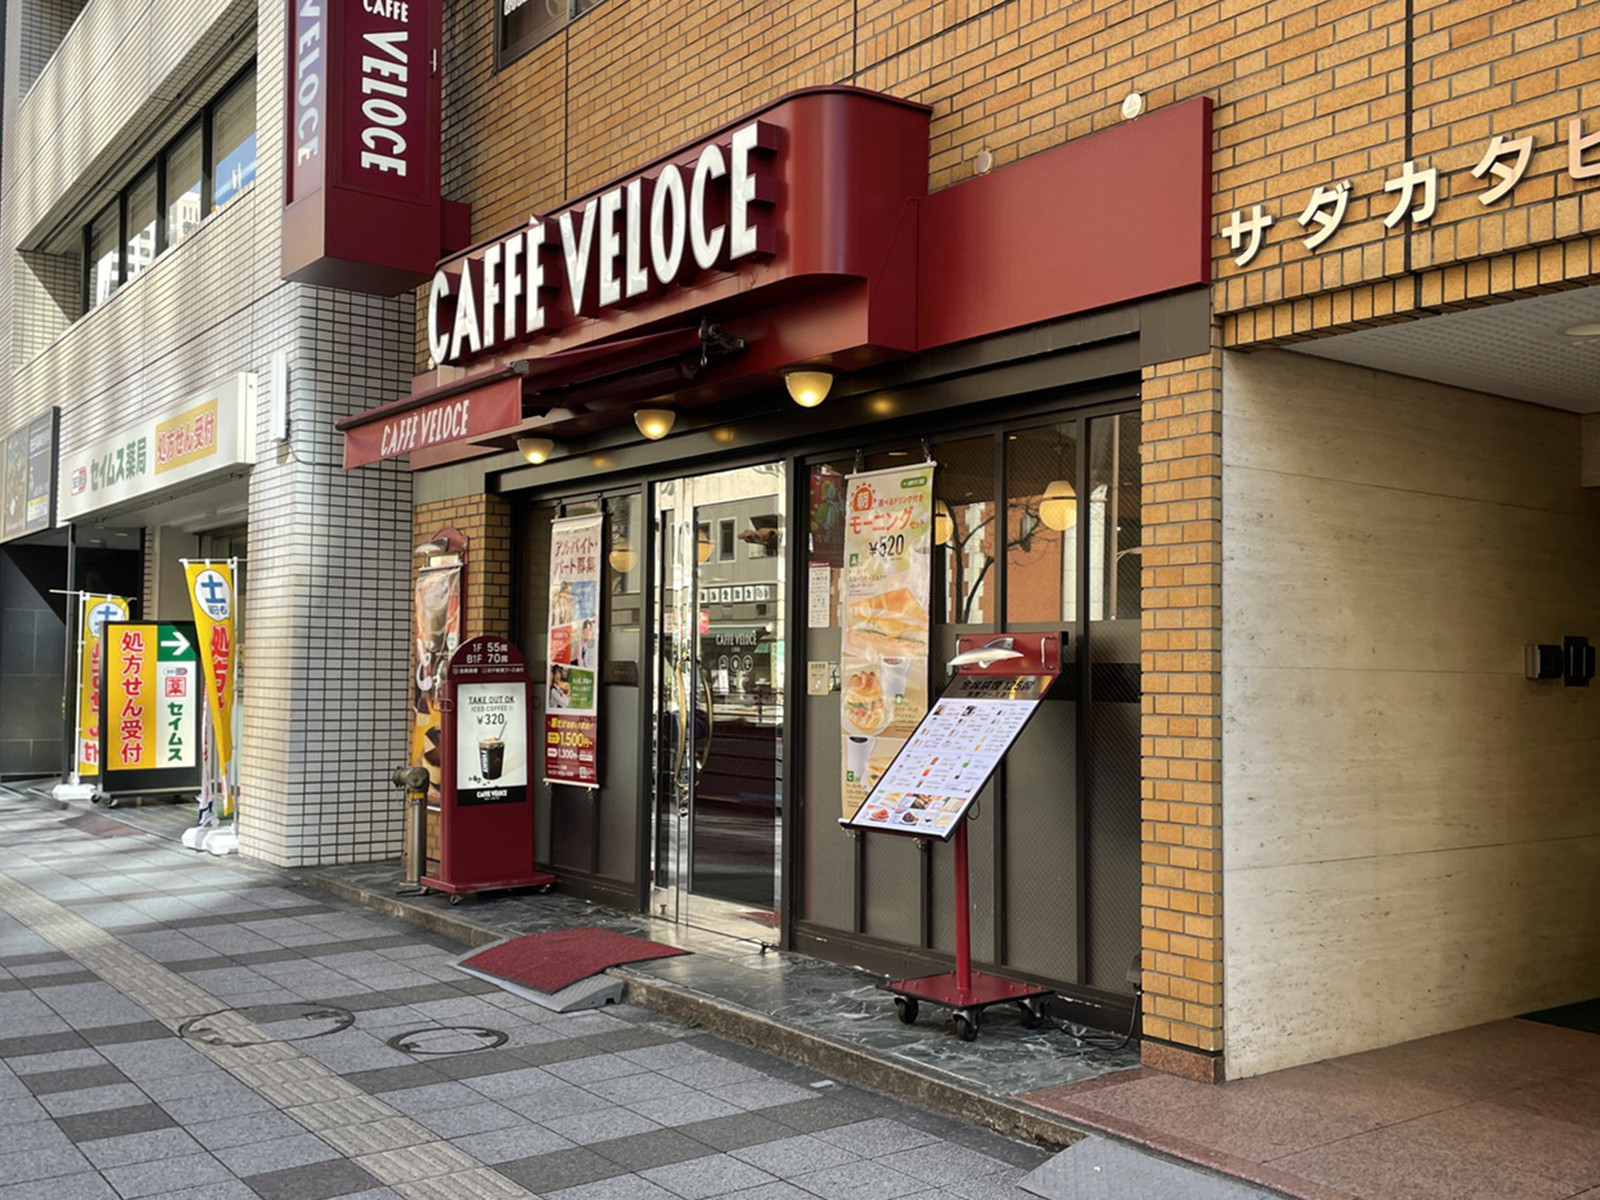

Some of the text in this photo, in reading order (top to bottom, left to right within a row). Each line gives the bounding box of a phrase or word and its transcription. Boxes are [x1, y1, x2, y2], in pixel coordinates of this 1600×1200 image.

[361, 31, 408, 177] VELOCE
[559, 123, 758, 316] VELOCE
[157, 408, 215, 465] 処方せん受付
[421, 399, 470, 445] VELOCE
[91, 436, 147, 492] セイムス薬局
[868, 534, 905, 557] ¥520
[201, 574, 226, 604] 土
[466, 654, 483, 664] B1F
[472, 643, 483, 653] 1F
[121, 631, 144, 764] 処方せん受付
[468, 695, 515, 705] TAKE OUT OK
[476, 713, 505, 725] ¥320
[167, 702, 184, 762] セイムス
